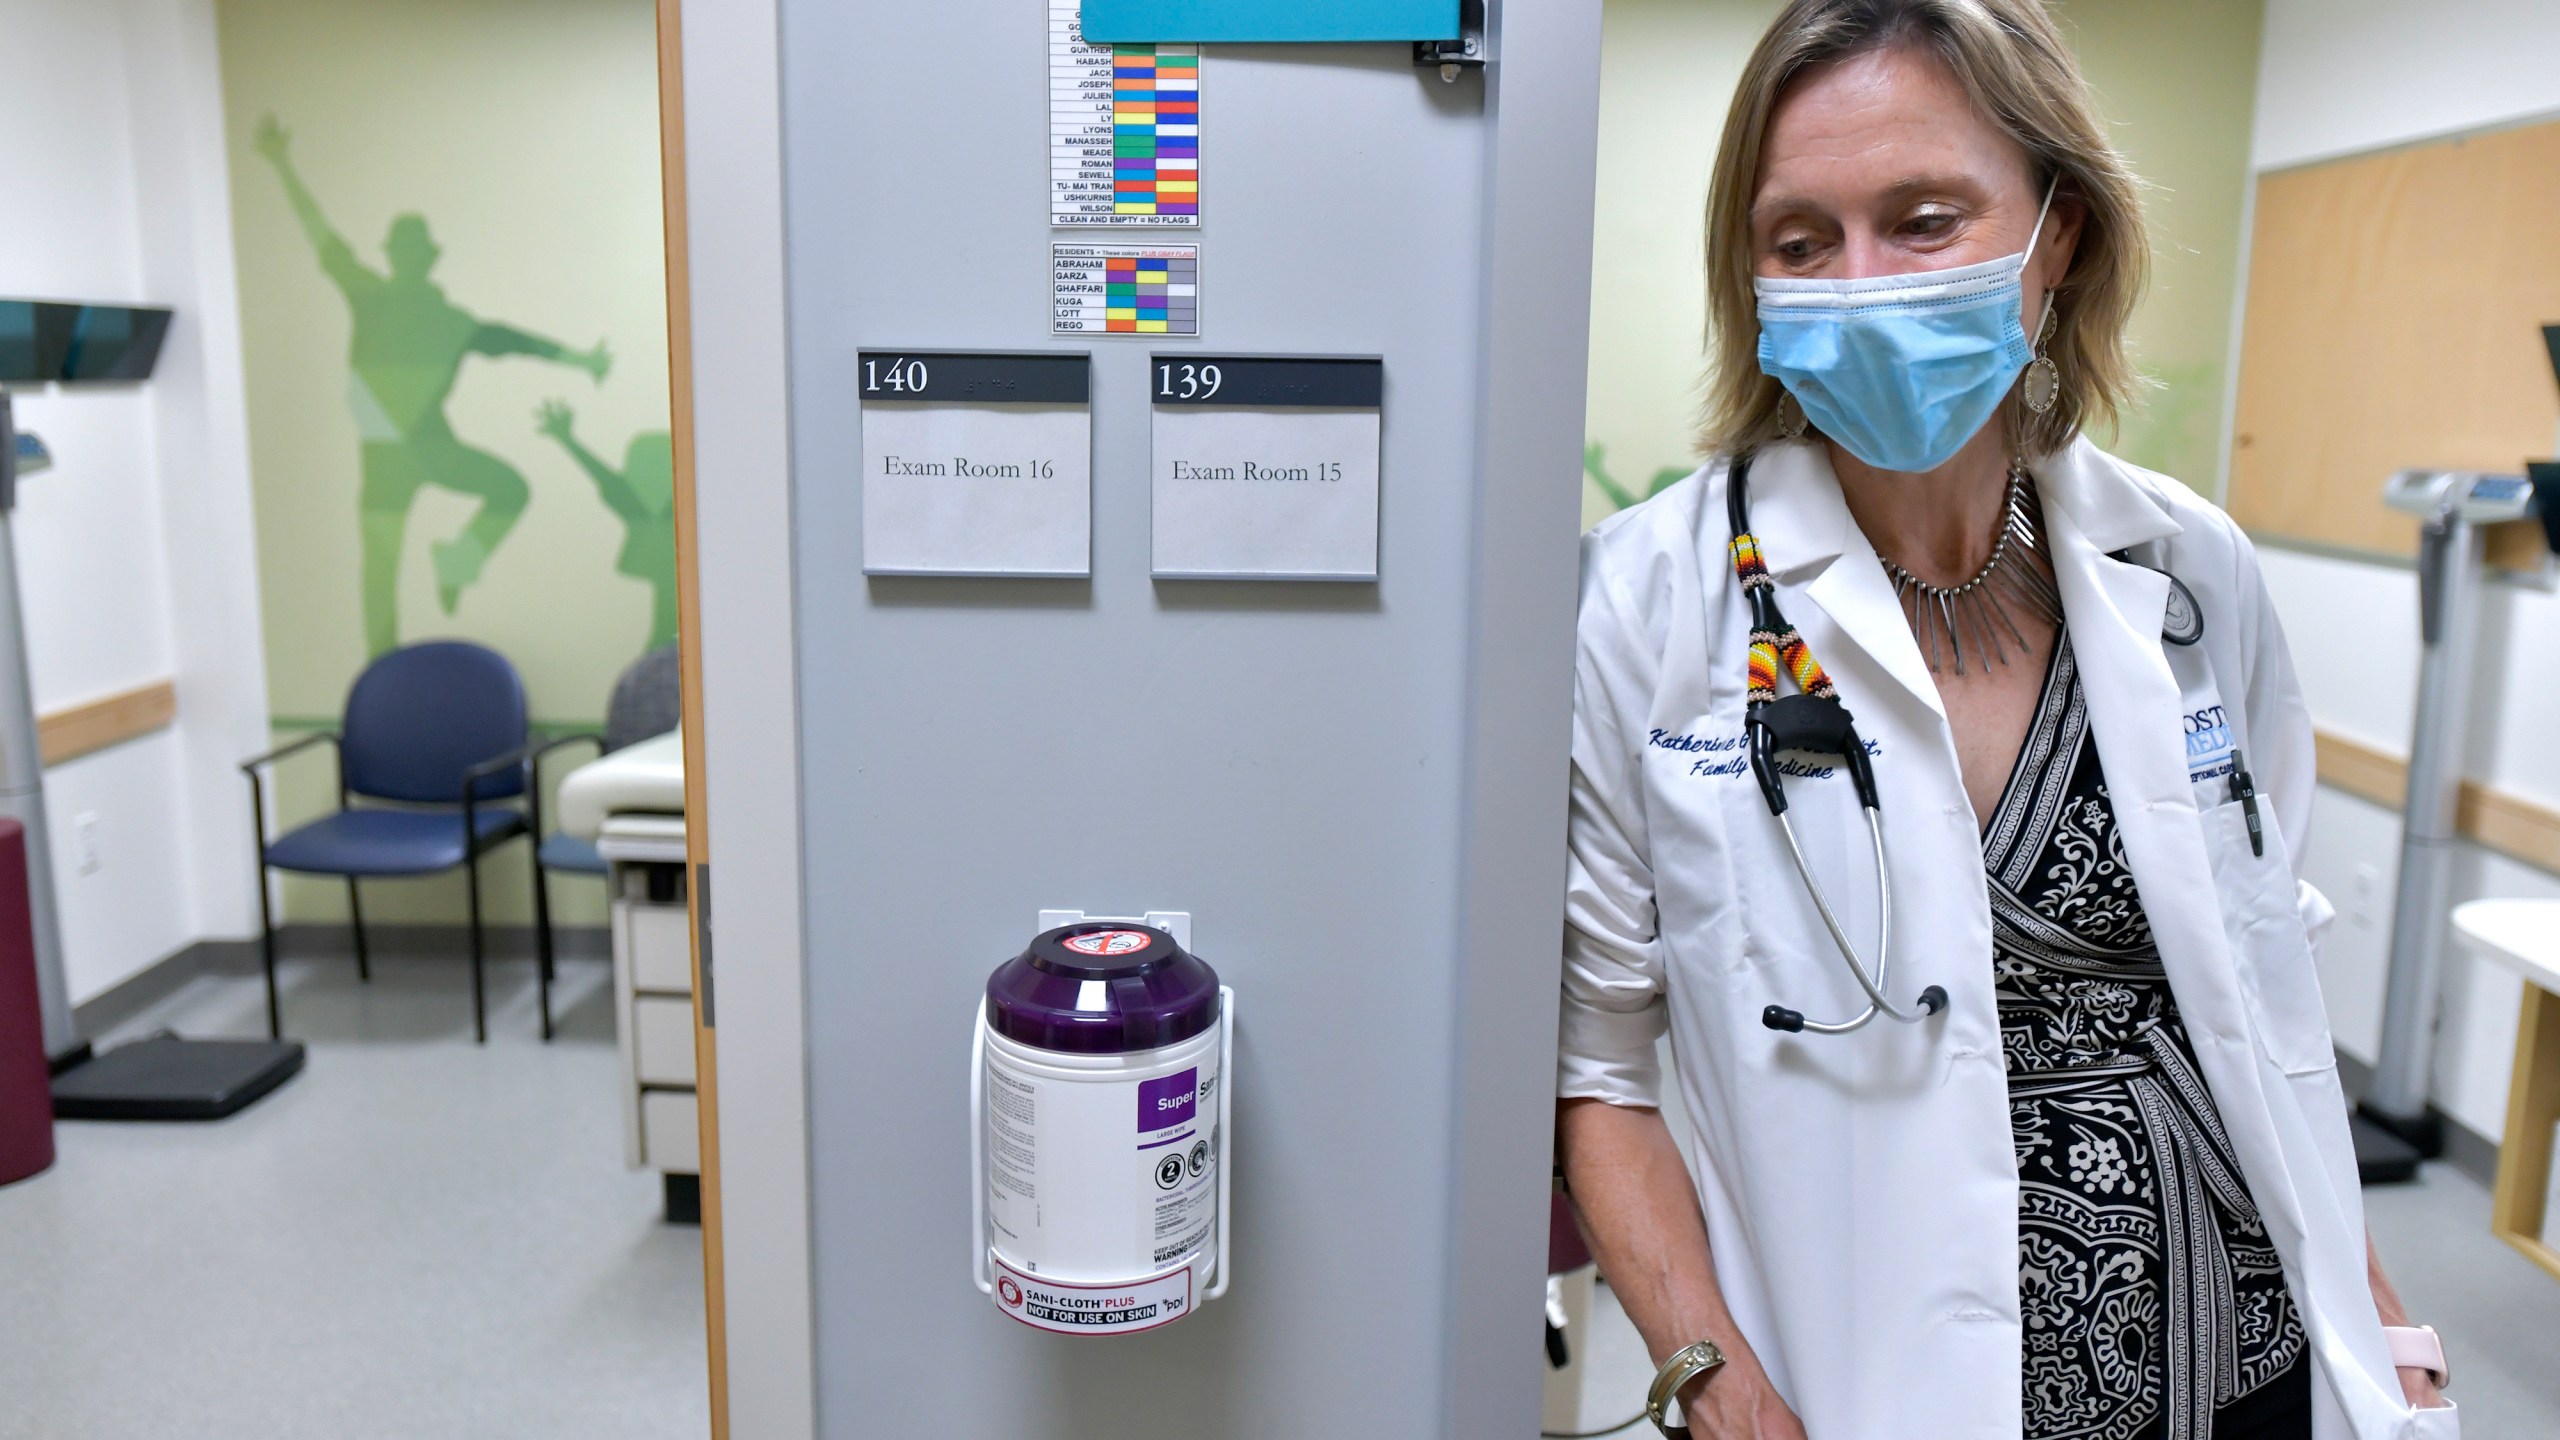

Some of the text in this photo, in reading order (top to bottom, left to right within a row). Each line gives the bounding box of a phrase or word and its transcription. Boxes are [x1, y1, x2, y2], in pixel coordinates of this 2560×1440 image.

[1070, 46, 1112, 54] GUNTHER
[1076, 58, 1112, 66] HABASH
[1089, 69, 1112, 77] JACK
[1082, 92, 1112, 100] JULIEN
[1083, 126, 1112, 134] LYONS
[1081, 160, 1112, 168] ROMAN
[1078, 171, 1112, 179] SEWELL
[1057, 182, 1071, 190] TU-
[1064, 194, 1112, 202] USHKURNIS
[1080, 205, 1113, 213] WILSON
[1059, 215, 1087, 224] CLEAN
[1090, 216, 1107, 224] AND
[1110, 216, 1138, 224] EMPTY
[1148, 216, 1160, 225] NO
[1162, 216, 1190, 225] FLAGS
[1055, 248, 1095, 256] RESIDENTS
[1056, 260, 1103, 269] ABRAHAM
[1056, 272, 1088, 280] GARZA
[1056, 284, 1103, 293] GHAFFARI
[1056, 297, 1083, 306] KUGA
[1056, 309, 1081, 318] LOTT
[1056, 321, 1083, 330] REGO
[864, 357, 929, 393] 140
[1158, 363, 1223, 400] 139
[884, 455, 1055, 481] Exam Room 16
[1172, 460, 1342, 483] Exam Room 15
[1649, 728, 1736, 753] Katherine
[1690, 755, 1835, 780] Family edicine
[1157, 1090, 1194, 1111] Super
[1156, 1125, 1187, 1139] LARGE WIPE
[1166, 1161, 1176, 1178] 2
[1154, 1246, 1168, 1255] KEEP
[1169, 1242, 1179, 1251] OUT
[1154, 1244, 1188, 1263] WARNING
[1105, 1296, 1135, 1308] PLUS
[1028, 1303, 1155, 1324] NOT FOR USE ON SKIN
